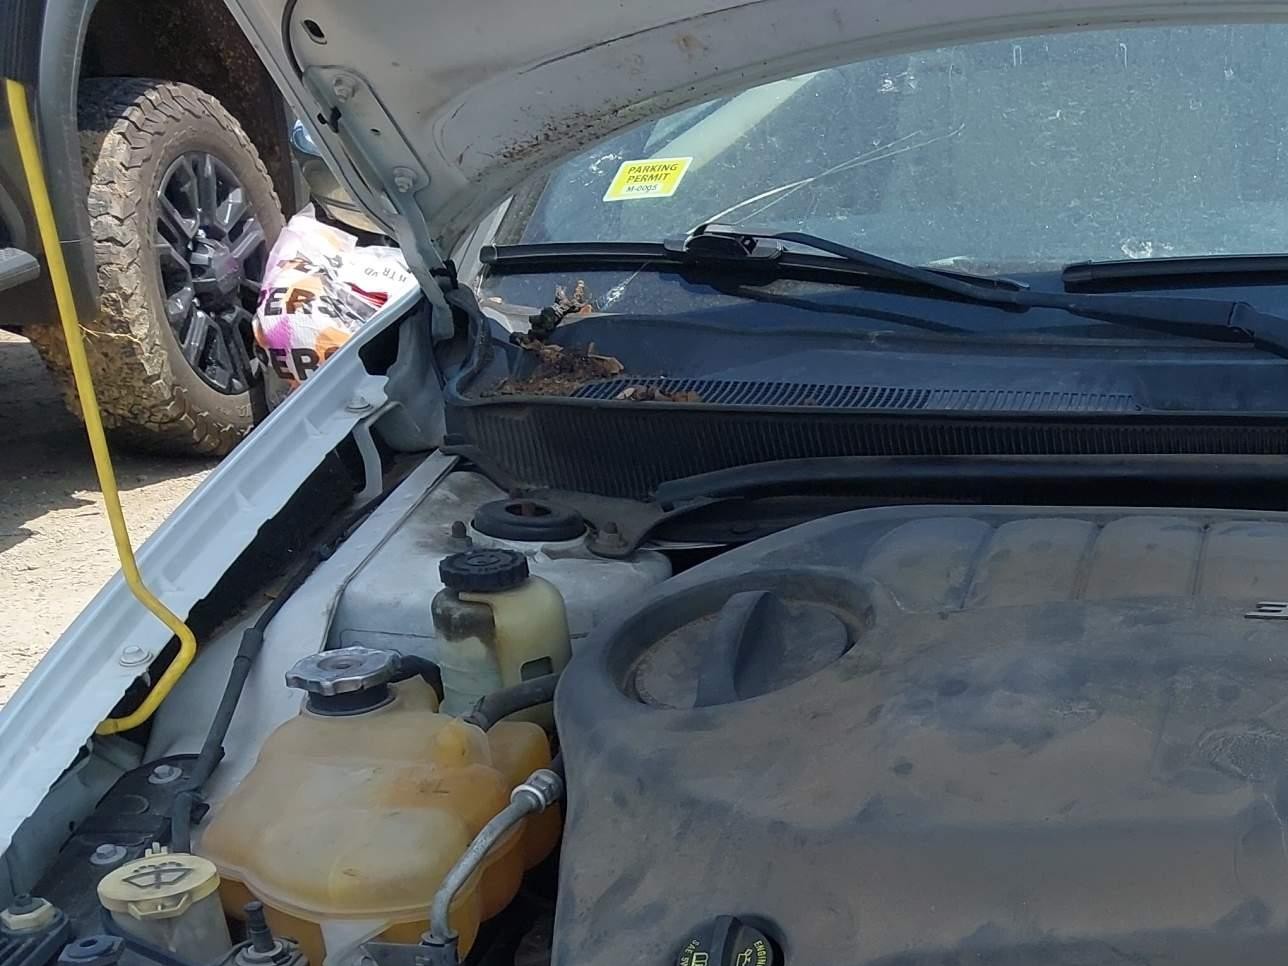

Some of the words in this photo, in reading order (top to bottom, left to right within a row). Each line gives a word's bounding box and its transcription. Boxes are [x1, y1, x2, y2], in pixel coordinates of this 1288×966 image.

[627, 163, 679, 174] PARKING
[626, 173, 671, 184] PERMIT
[685, 940, 700, 954] SAE
